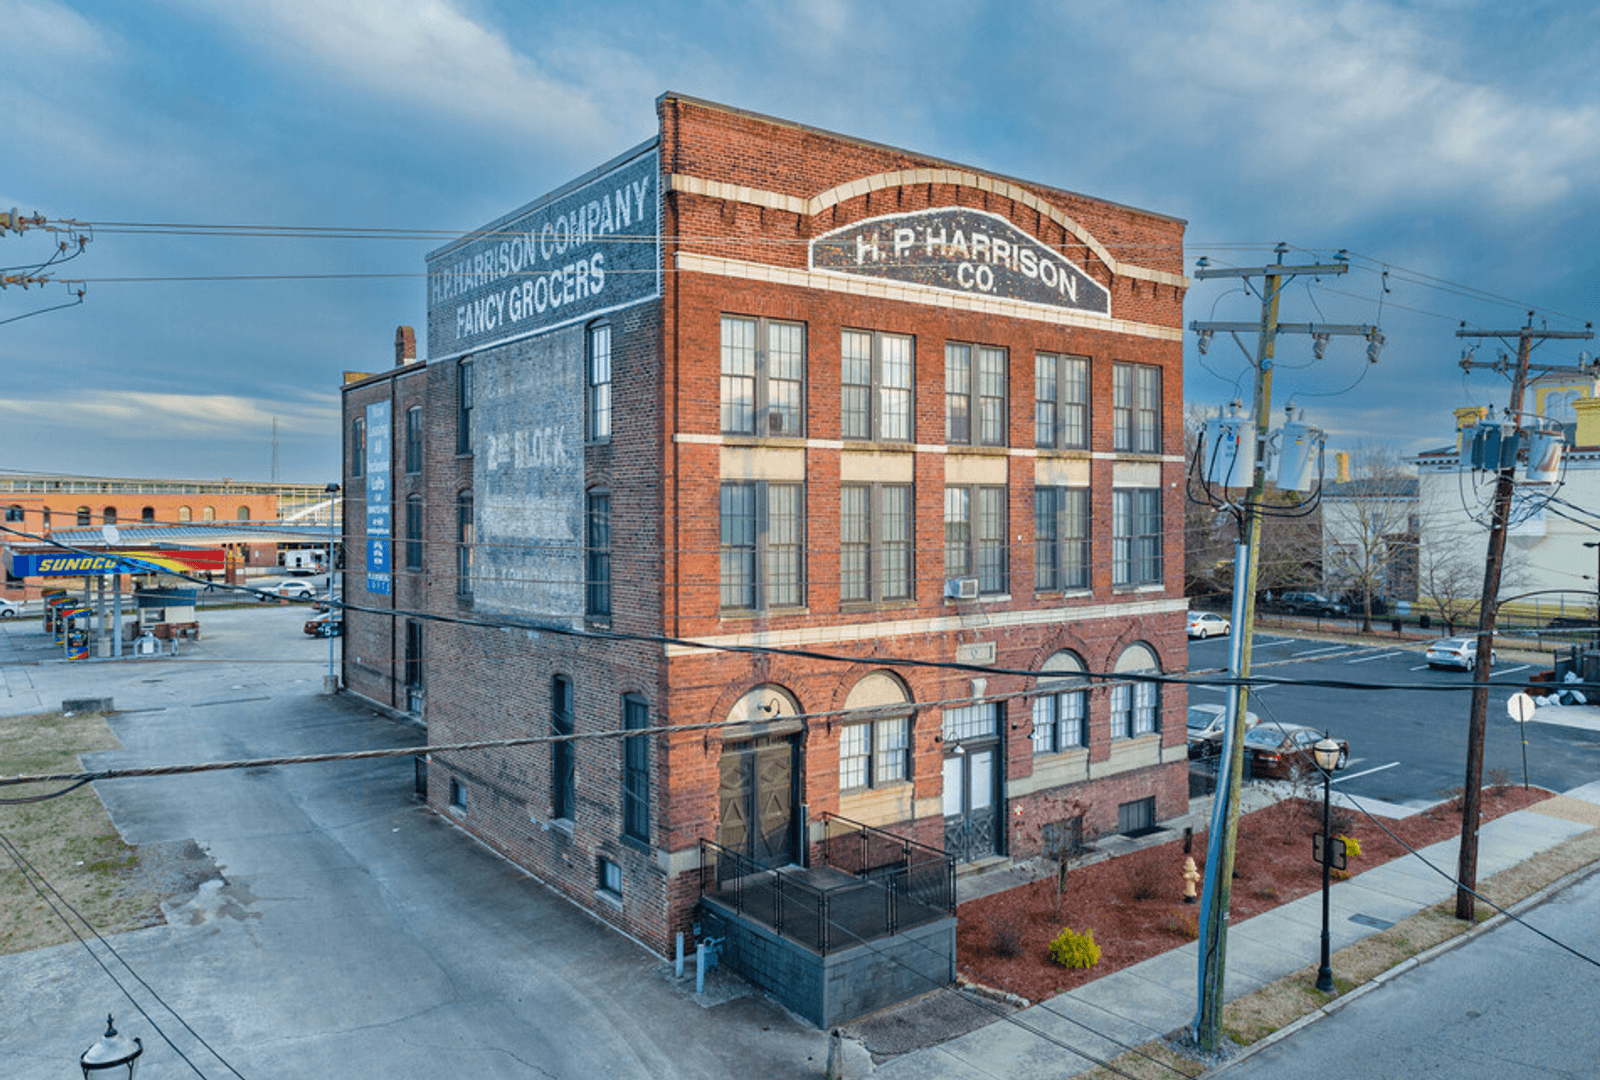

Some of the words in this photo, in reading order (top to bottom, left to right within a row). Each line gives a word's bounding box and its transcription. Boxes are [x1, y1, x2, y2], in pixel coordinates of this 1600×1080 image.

[541, 176, 649, 260] COMPANY
[456, 290, 506, 339] FANCY
[509, 252, 605, 323] GROCERS
[926, 227, 1079, 302] HARRISON
[957, 261, 998, 294] CO.
